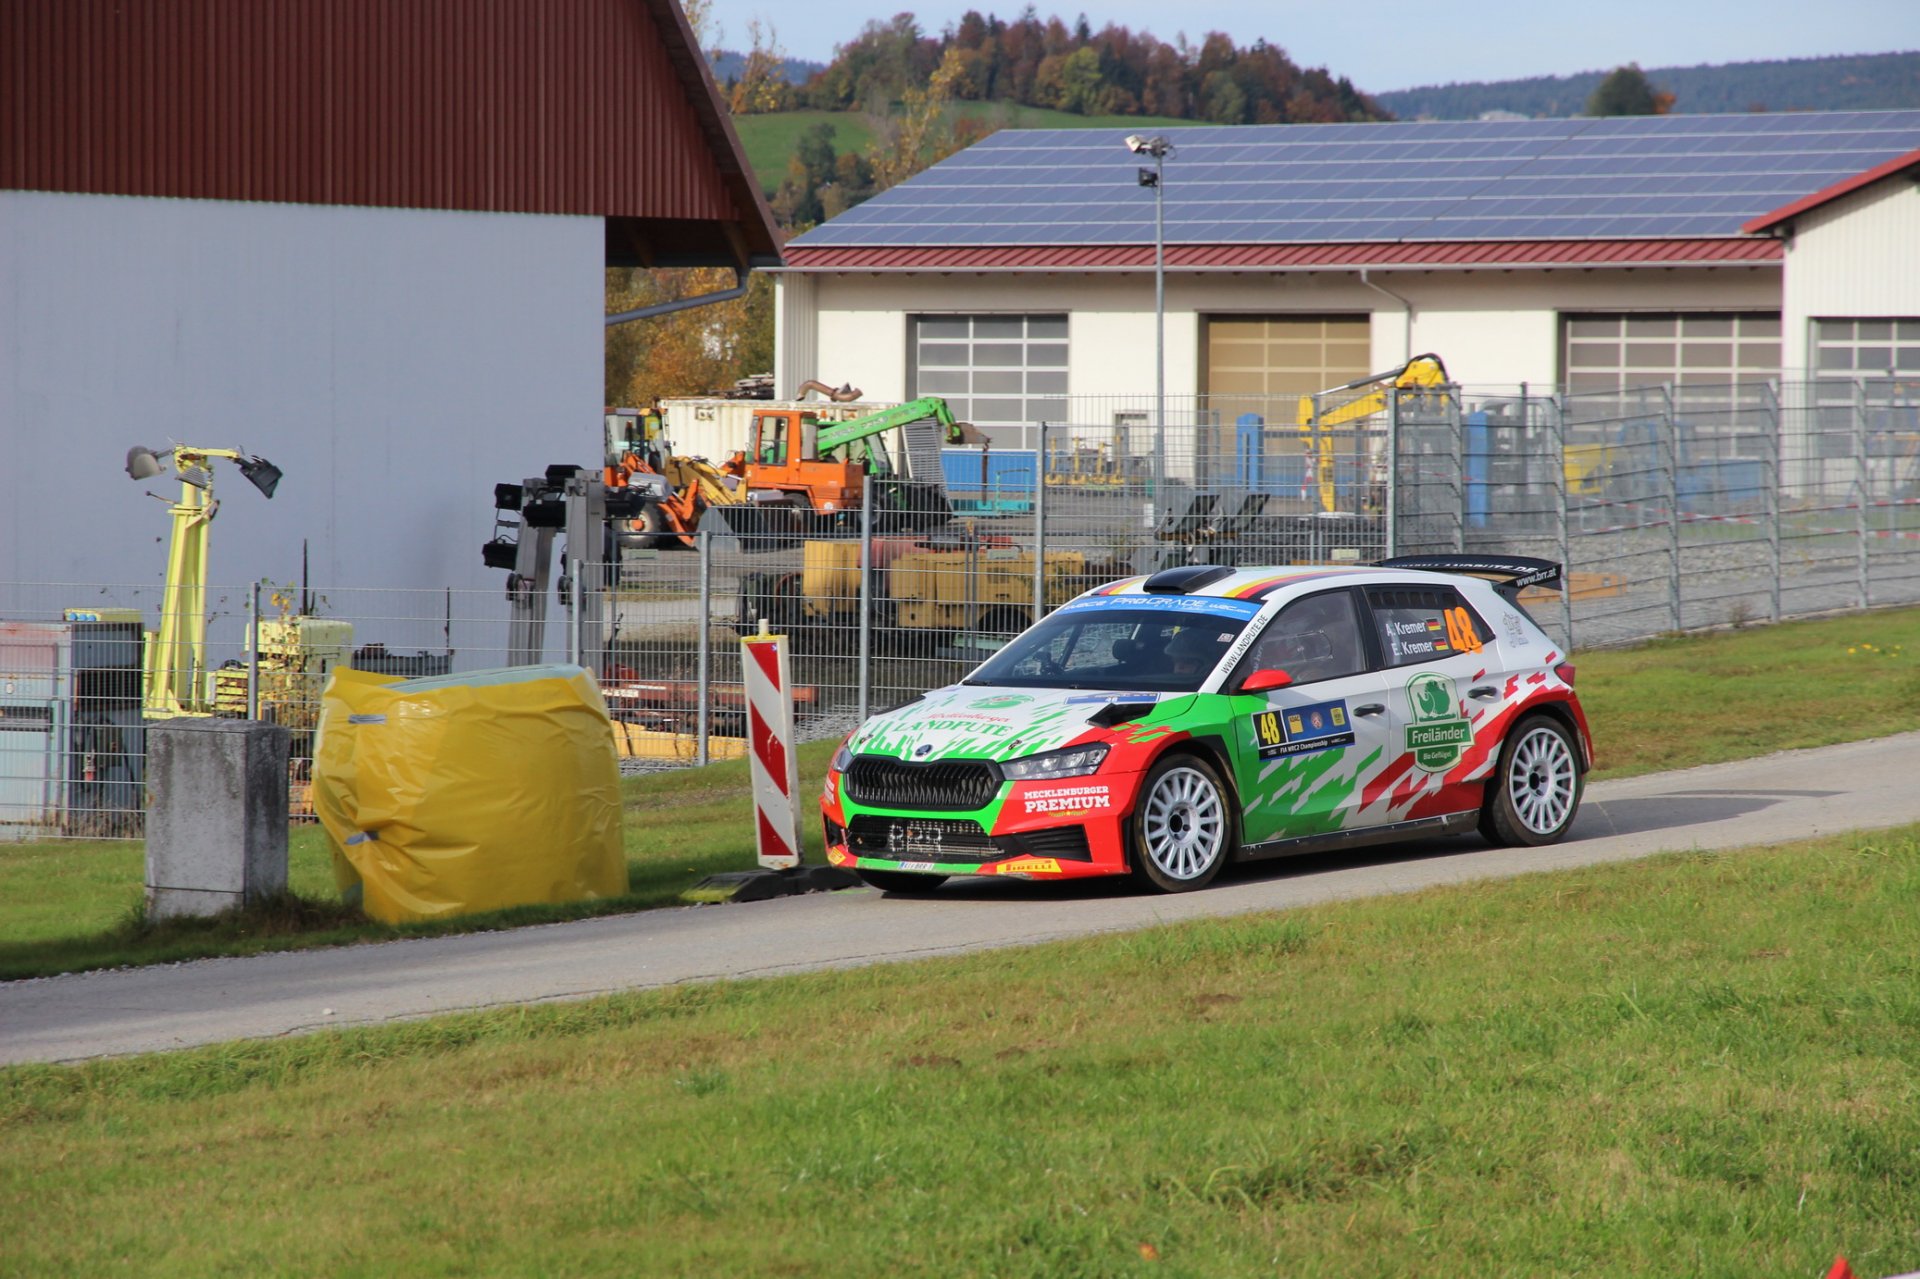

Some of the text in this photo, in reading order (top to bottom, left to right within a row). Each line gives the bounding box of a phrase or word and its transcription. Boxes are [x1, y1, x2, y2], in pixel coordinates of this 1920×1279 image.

[1516, 567, 1557, 587] www.brr.at
[1385, 621, 1426, 636] A. Kremer
[1443, 606, 1484, 655] 48
[1221, 614, 1268, 674] WWW.LANDPUTE.DE
[1391, 640, 1434, 656] E. Kremer
[893, 720, 1013, 736] LANDPUTE
[1261, 712, 1280, 745] 48
[1412, 726, 1465, 744] Freiländer
[1280, 746, 1288, 754] FIA
[1288, 744, 1300, 752] WRC2
[1300, 740, 1328, 751] Championship
[1024, 786, 1109, 799] MECKLENBURGER
[1024, 795, 1110, 813] PREMIUM
[1006, 863, 1052, 872] PIRELLI
